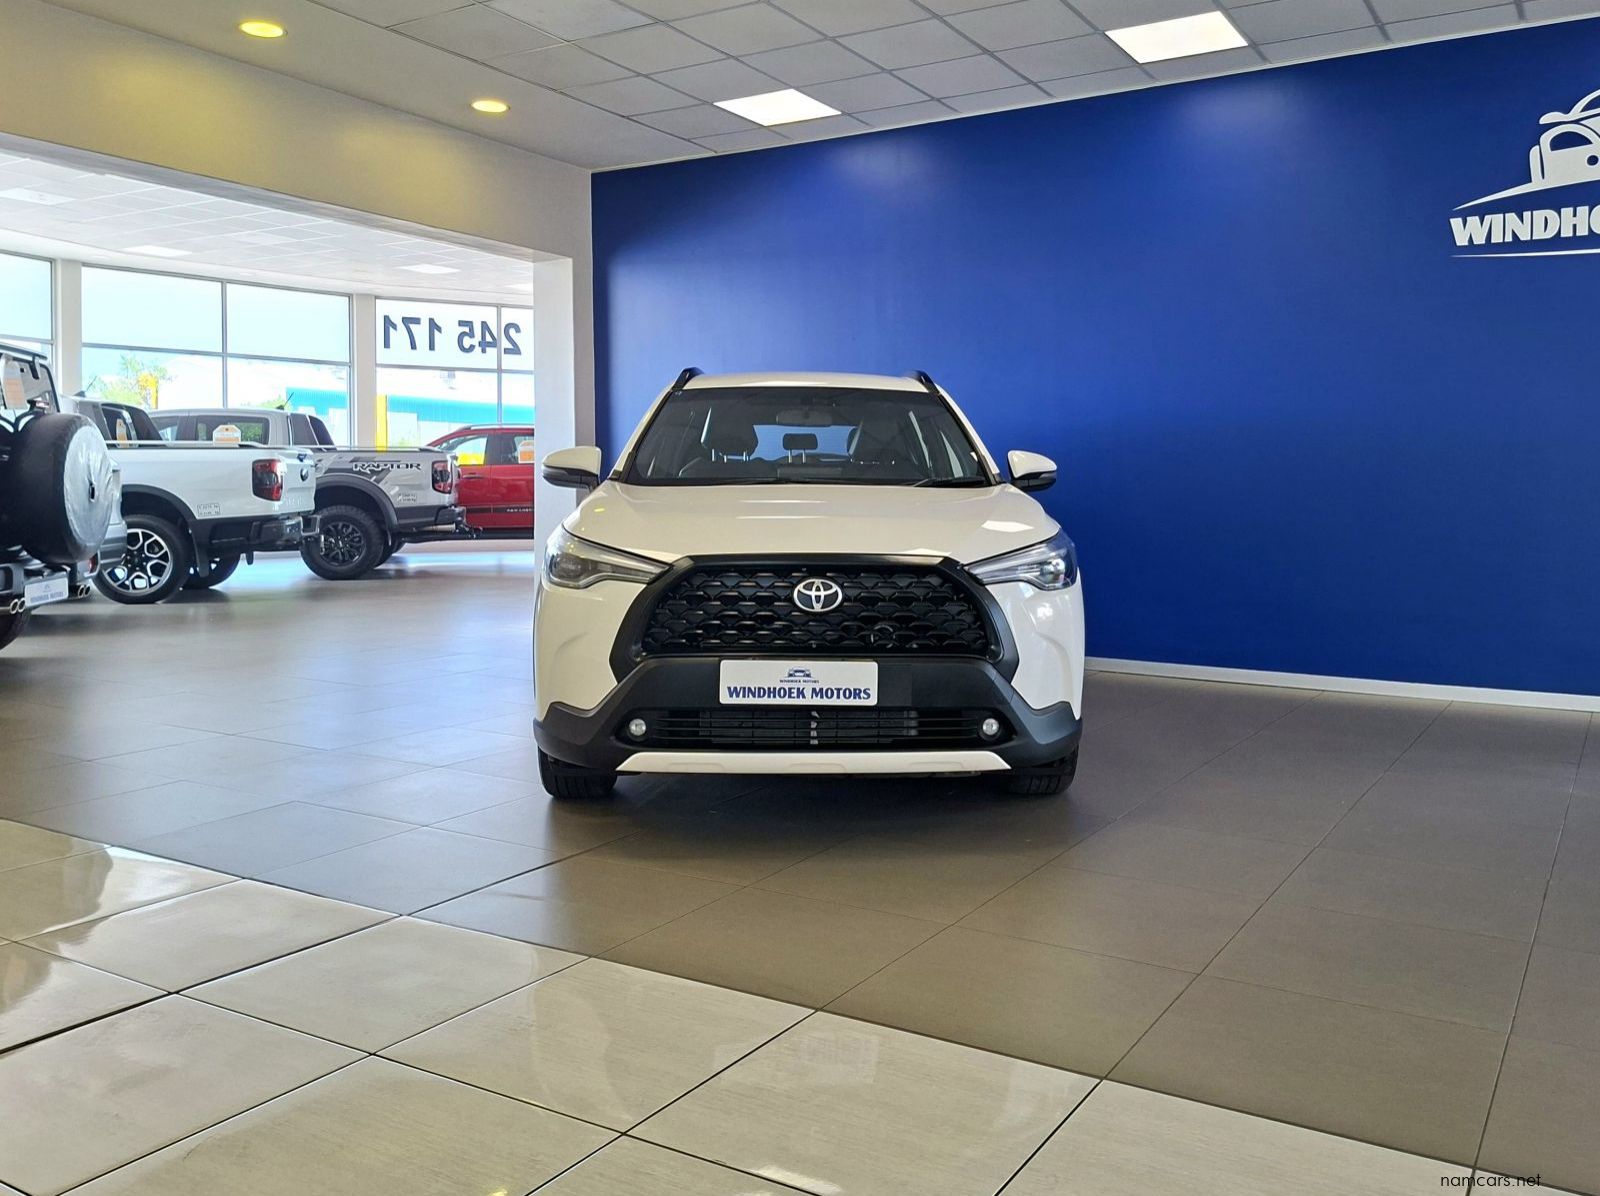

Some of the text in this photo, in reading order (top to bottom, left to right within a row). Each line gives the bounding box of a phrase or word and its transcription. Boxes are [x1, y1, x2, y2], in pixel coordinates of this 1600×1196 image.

[352, 461, 422, 474] RAPTOR
[727, 686, 871, 701] WINDHOEK MOTORS
